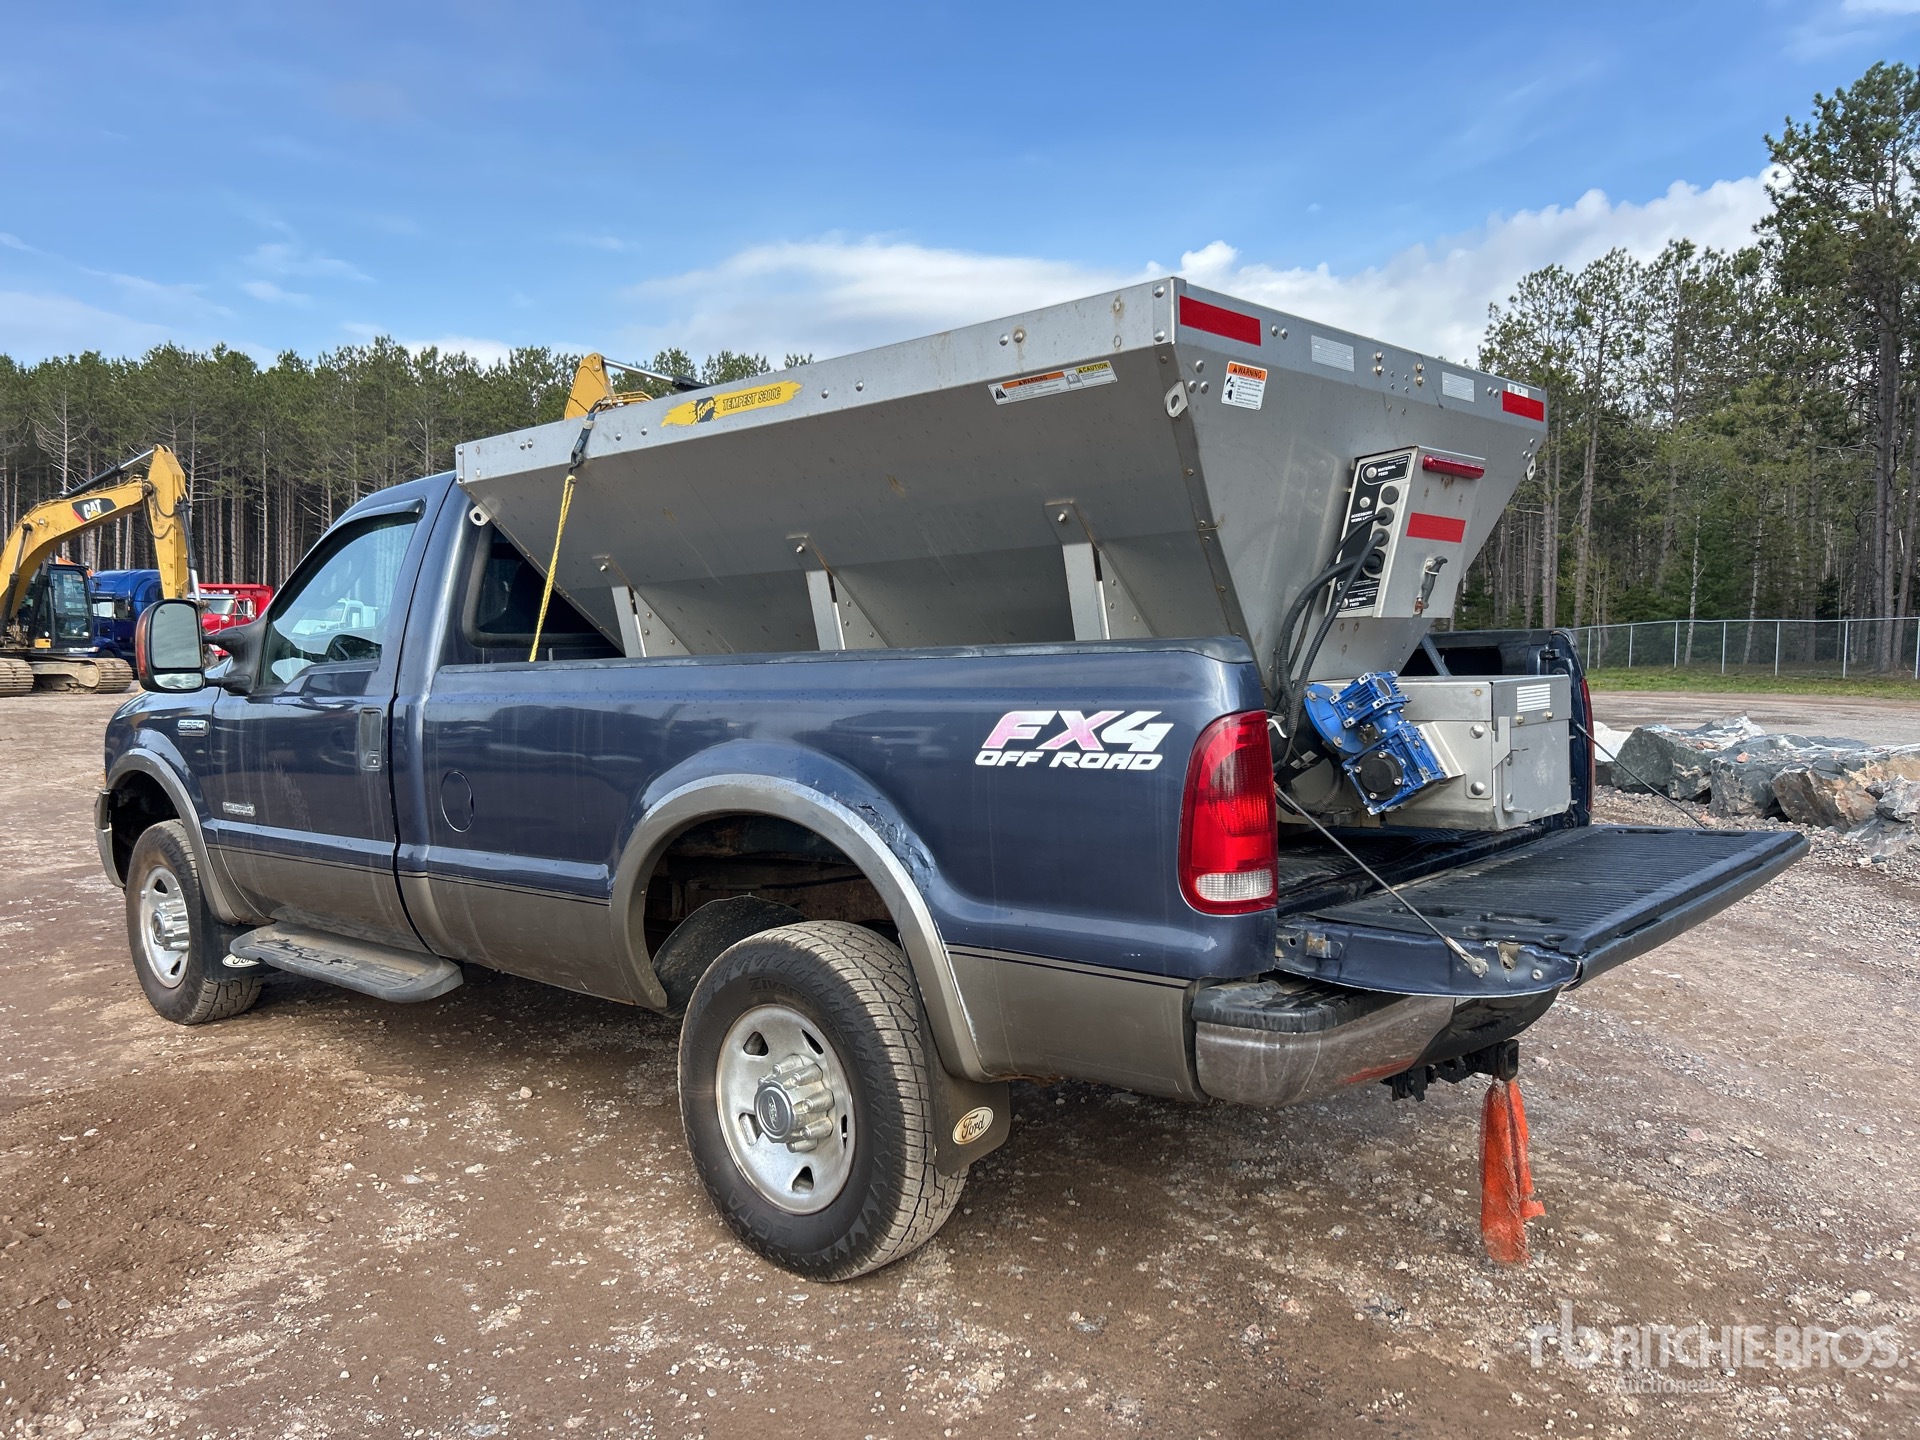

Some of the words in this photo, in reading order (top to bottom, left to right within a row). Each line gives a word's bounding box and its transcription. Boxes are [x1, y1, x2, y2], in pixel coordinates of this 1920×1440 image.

[723, 392, 757, 411] TEMPEST
[83, 498, 102, 520] CAT
[981, 710, 1174, 752] FX4
[974, 750, 1045, 767] OFF
[1049, 751, 1164, 771] ROAD
[961, 1113, 985, 1140] Ford
